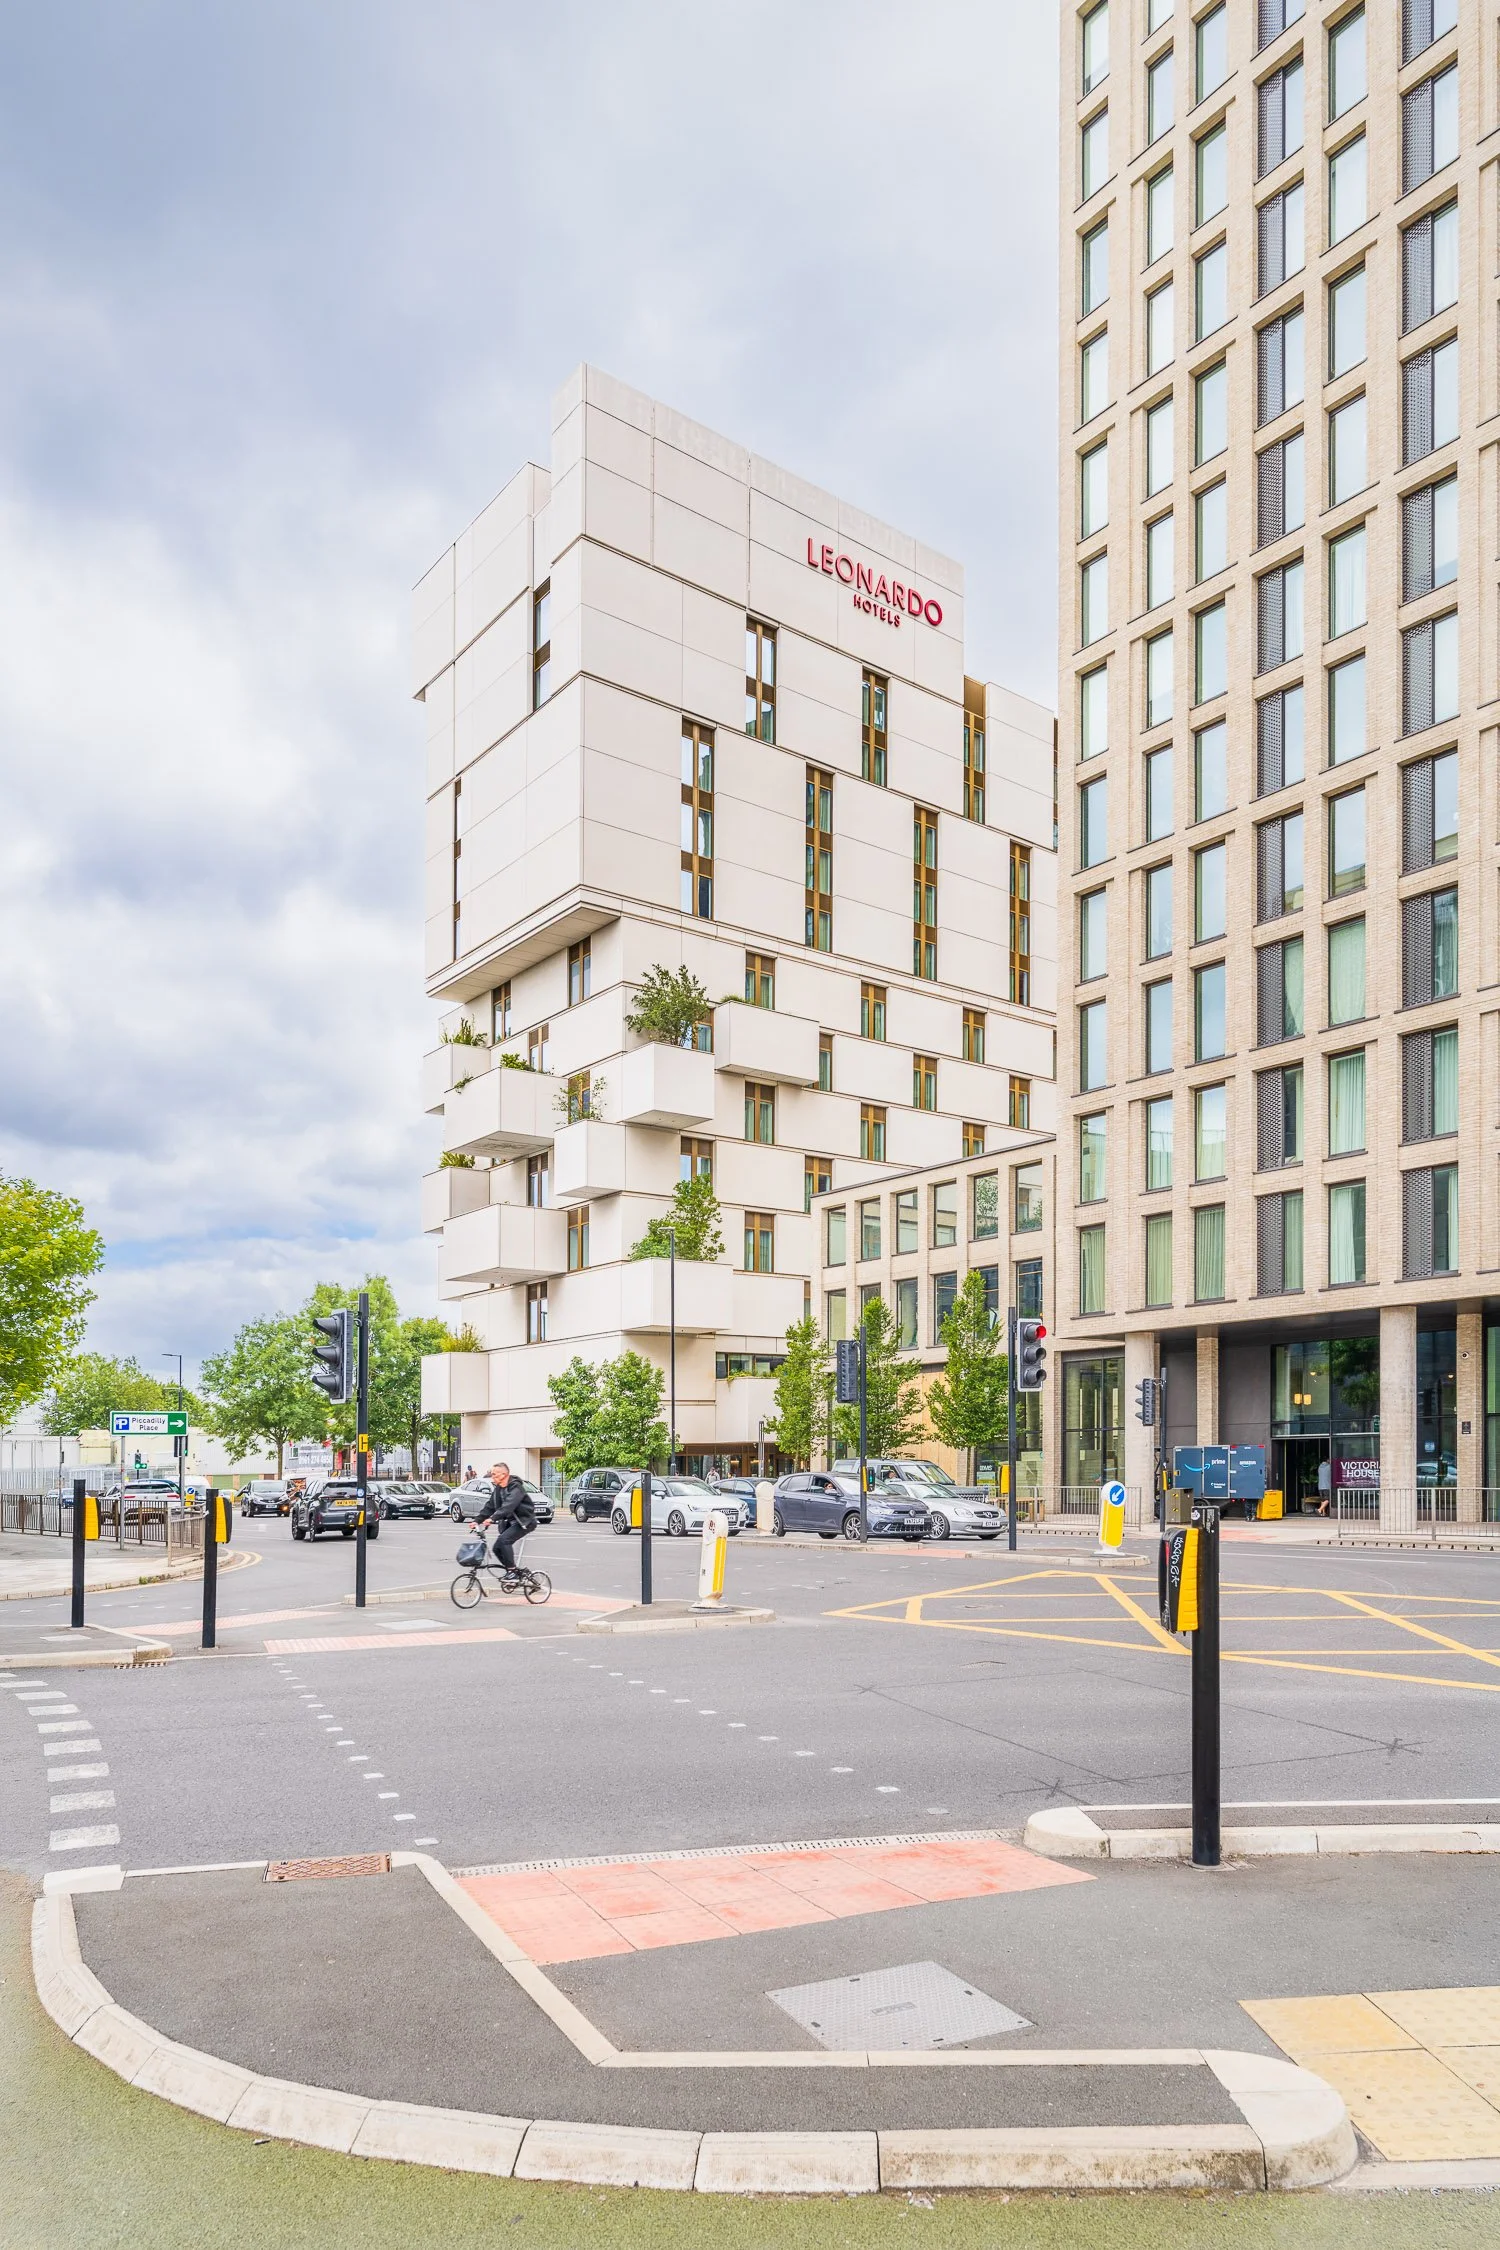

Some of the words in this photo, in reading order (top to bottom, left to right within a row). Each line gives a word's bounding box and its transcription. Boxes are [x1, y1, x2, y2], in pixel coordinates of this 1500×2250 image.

[807, 537, 943, 627] LEONARDO
[853, 593, 901, 628] HOTELS
[131, 1417, 166, 1425] Piccadilly
[1211, 1458, 1226, 1466] prime
[1340, 1461, 1381, 1470] VICTORI
[1346, 1469, 1381, 1478] HOUSE
